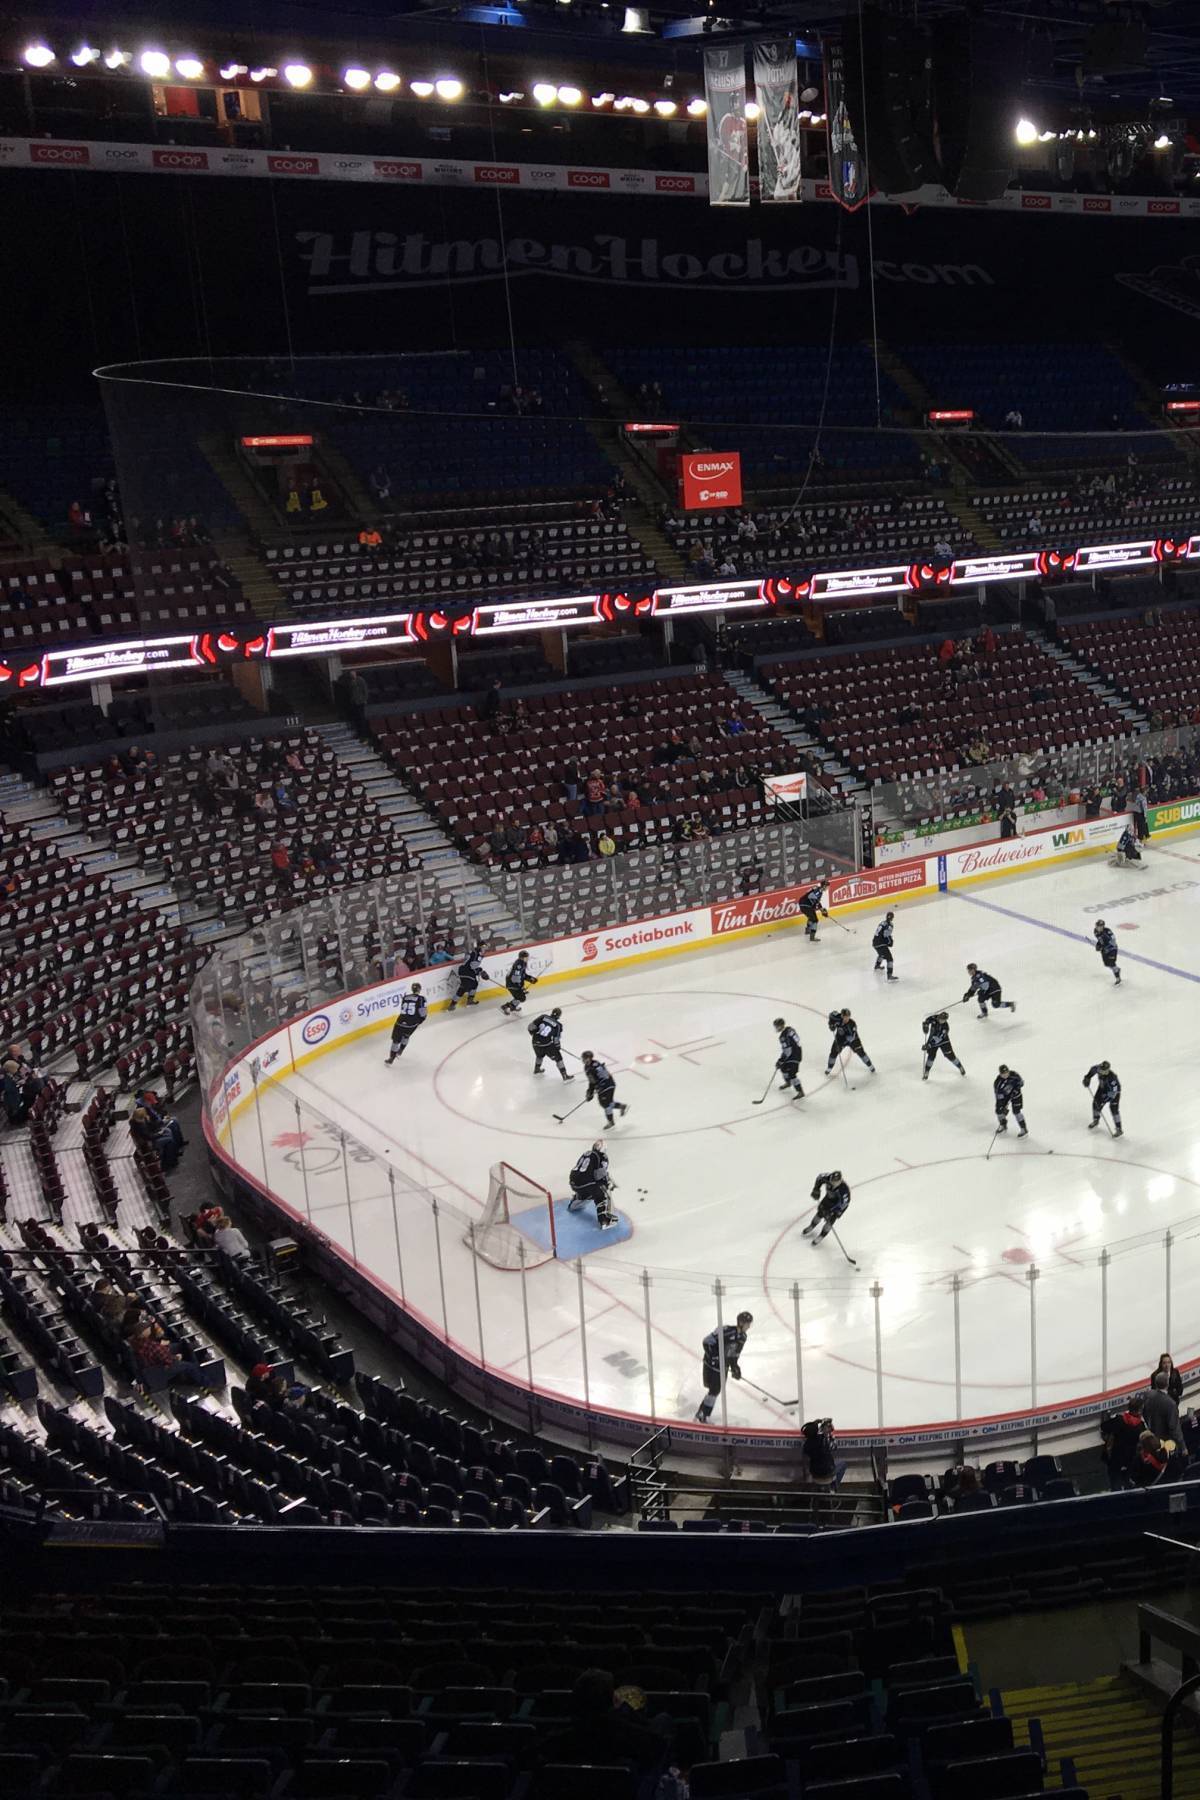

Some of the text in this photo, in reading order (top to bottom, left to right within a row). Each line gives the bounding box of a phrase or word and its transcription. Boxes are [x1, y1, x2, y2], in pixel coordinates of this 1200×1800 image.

[697, 461, 734, 472] ENMAX
[1052, 829, 1086, 847] WM
[958, 843, 1043, 874] Budweiser
[878, 875, 922, 891] BETTER PIZZA
[832, 886, 852, 902] PAPA
[715, 906, 748, 932] Tim
[605, 921, 693, 952] Scotiabank
[357, 991, 407, 1017] Synergy
[1000, 1420, 1024, 1433] KEEPING
[1032, 1416, 1050, 1427] FRESH
[918, 1432, 942, 1442] KEEPING
[951, 1429, 970, 1440] FRESH
